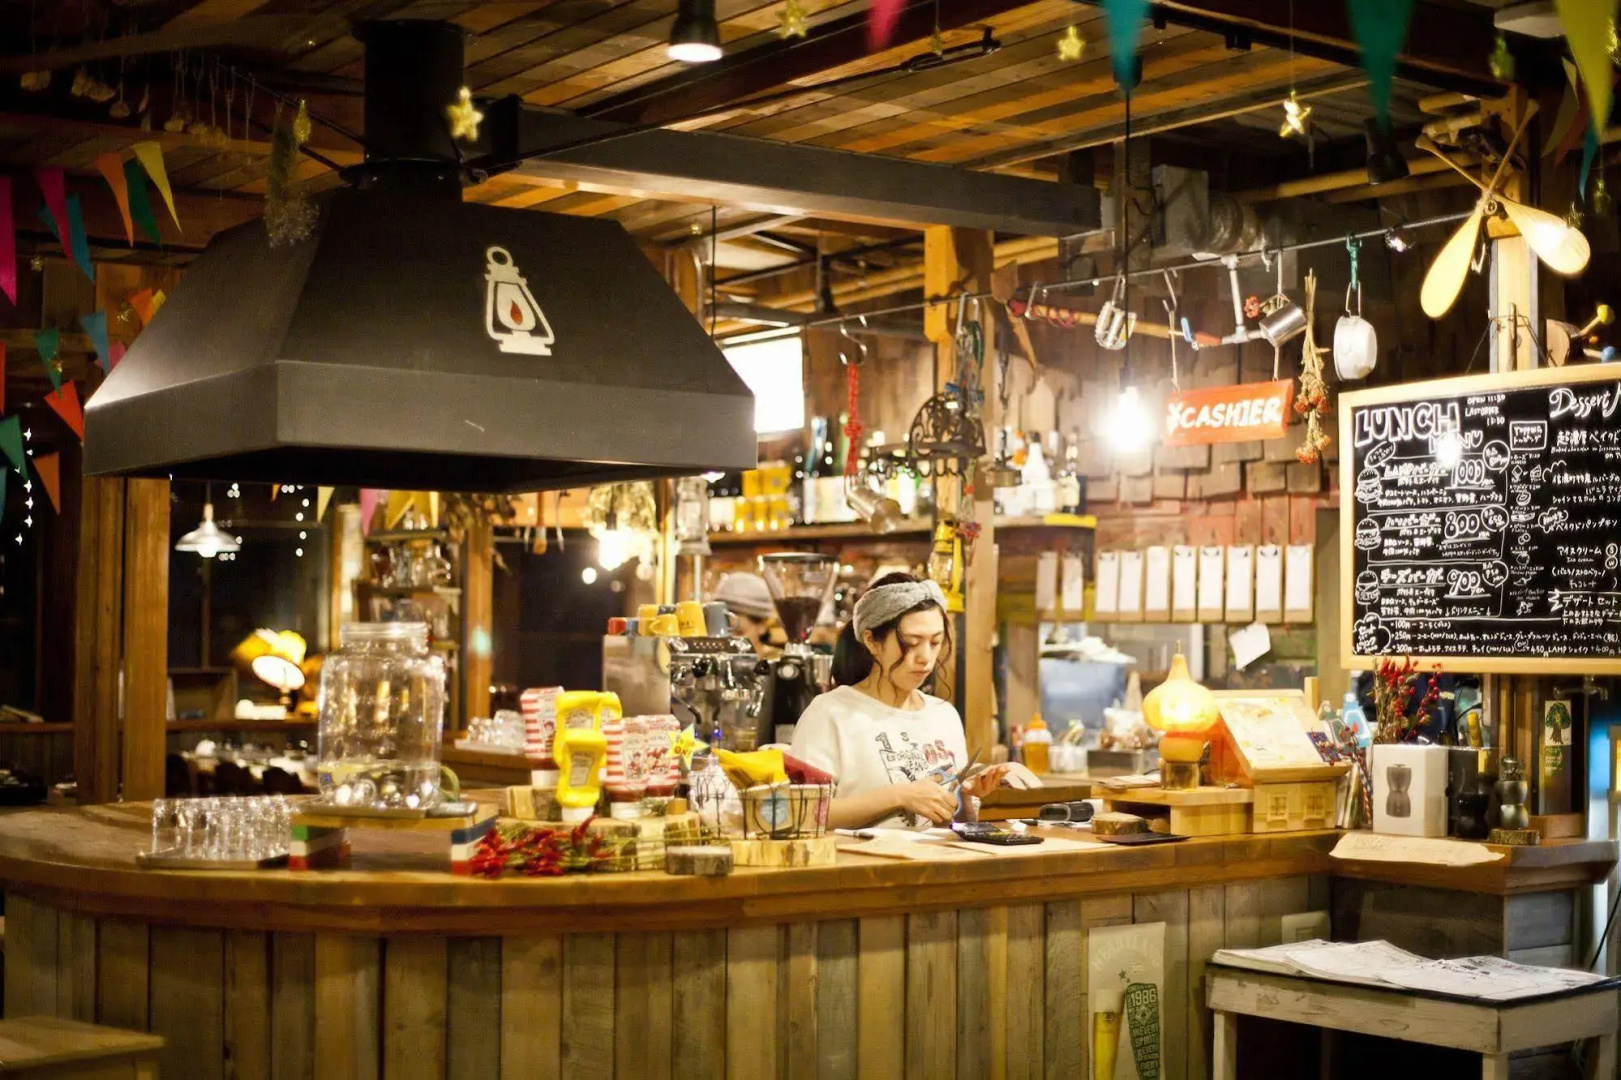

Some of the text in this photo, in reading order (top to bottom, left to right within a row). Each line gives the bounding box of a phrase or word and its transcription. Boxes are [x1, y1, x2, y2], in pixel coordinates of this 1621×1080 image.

[1467, 396, 1486, 405] OPEN
[1549, 388, 1610, 418] Dessert
[1354, 402, 1460, 448] LUNCH
[1451, 459, 1485, 488] 1000
[1444, 511, 1480, 539] 800
[1557, 546, 1602, 556] アイスクリーム
[1446, 569, 1481, 596] 900
[1131, 988, 1157, 1007] 1986
